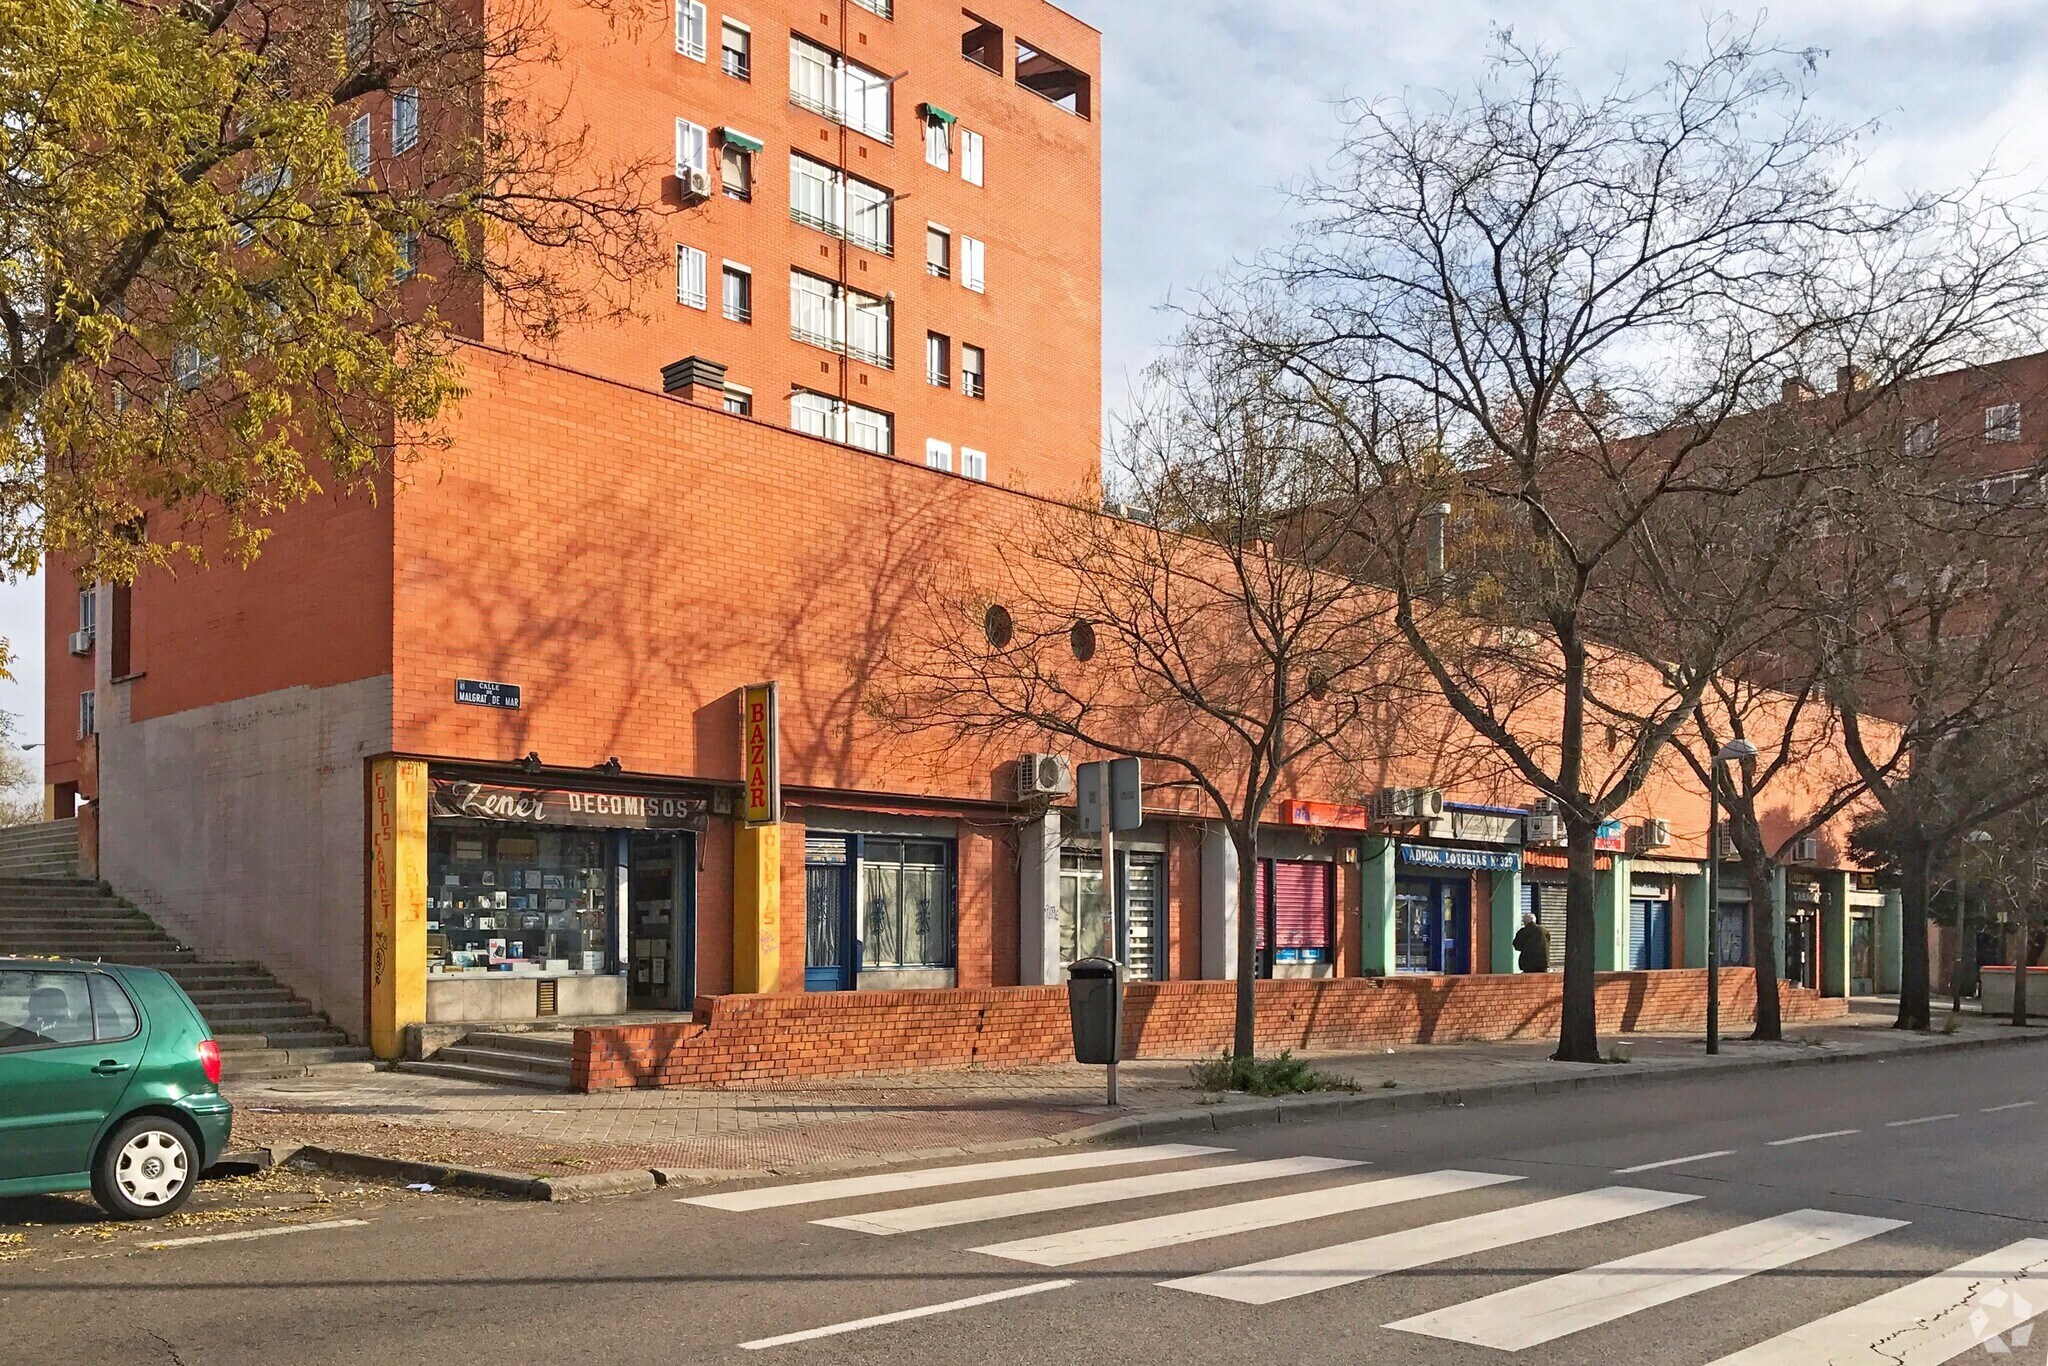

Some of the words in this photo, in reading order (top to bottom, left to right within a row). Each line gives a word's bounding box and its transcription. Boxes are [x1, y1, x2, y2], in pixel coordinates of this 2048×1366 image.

[459, 692, 487, 704] MALGRAT
[492, 695, 500, 705] DE
[505, 697, 519, 707] MAR
[479, 682, 500, 691] CALLE
[750, 703, 765, 808] BAZAR
[375, 772, 391, 840] FOTOS
[452, 780, 547, 821] Zener
[569, 793, 688, 818] DECOMISOS
[374, 832, 391, 919] CARNET
[1409, 849, 1441, 863] ADMON.
[1445, 852, 1487, 866] LOTERIAS
[1500, 856, 1514, 868] 329
